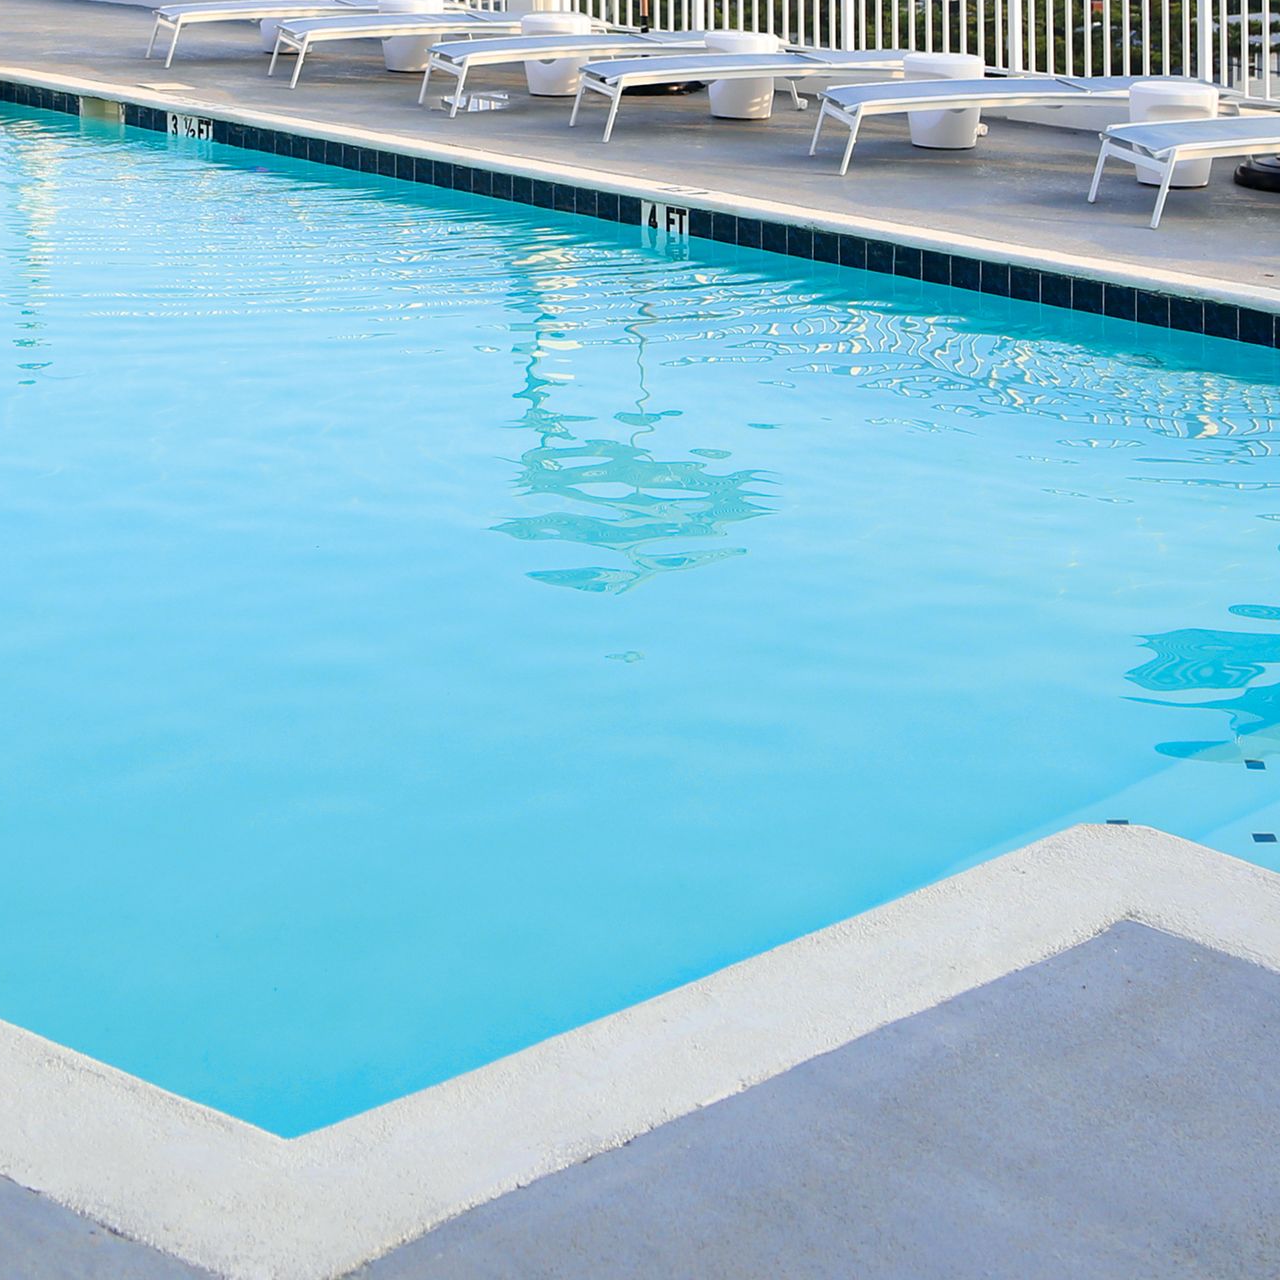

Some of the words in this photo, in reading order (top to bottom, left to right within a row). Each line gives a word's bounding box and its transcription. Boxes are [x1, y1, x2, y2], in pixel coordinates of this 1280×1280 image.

[172, 114, 178, 136] 3
[198, 119, 211, 141] FT
[648, 202, 658, 229] 4
[666, 206, 687, 235] FT
